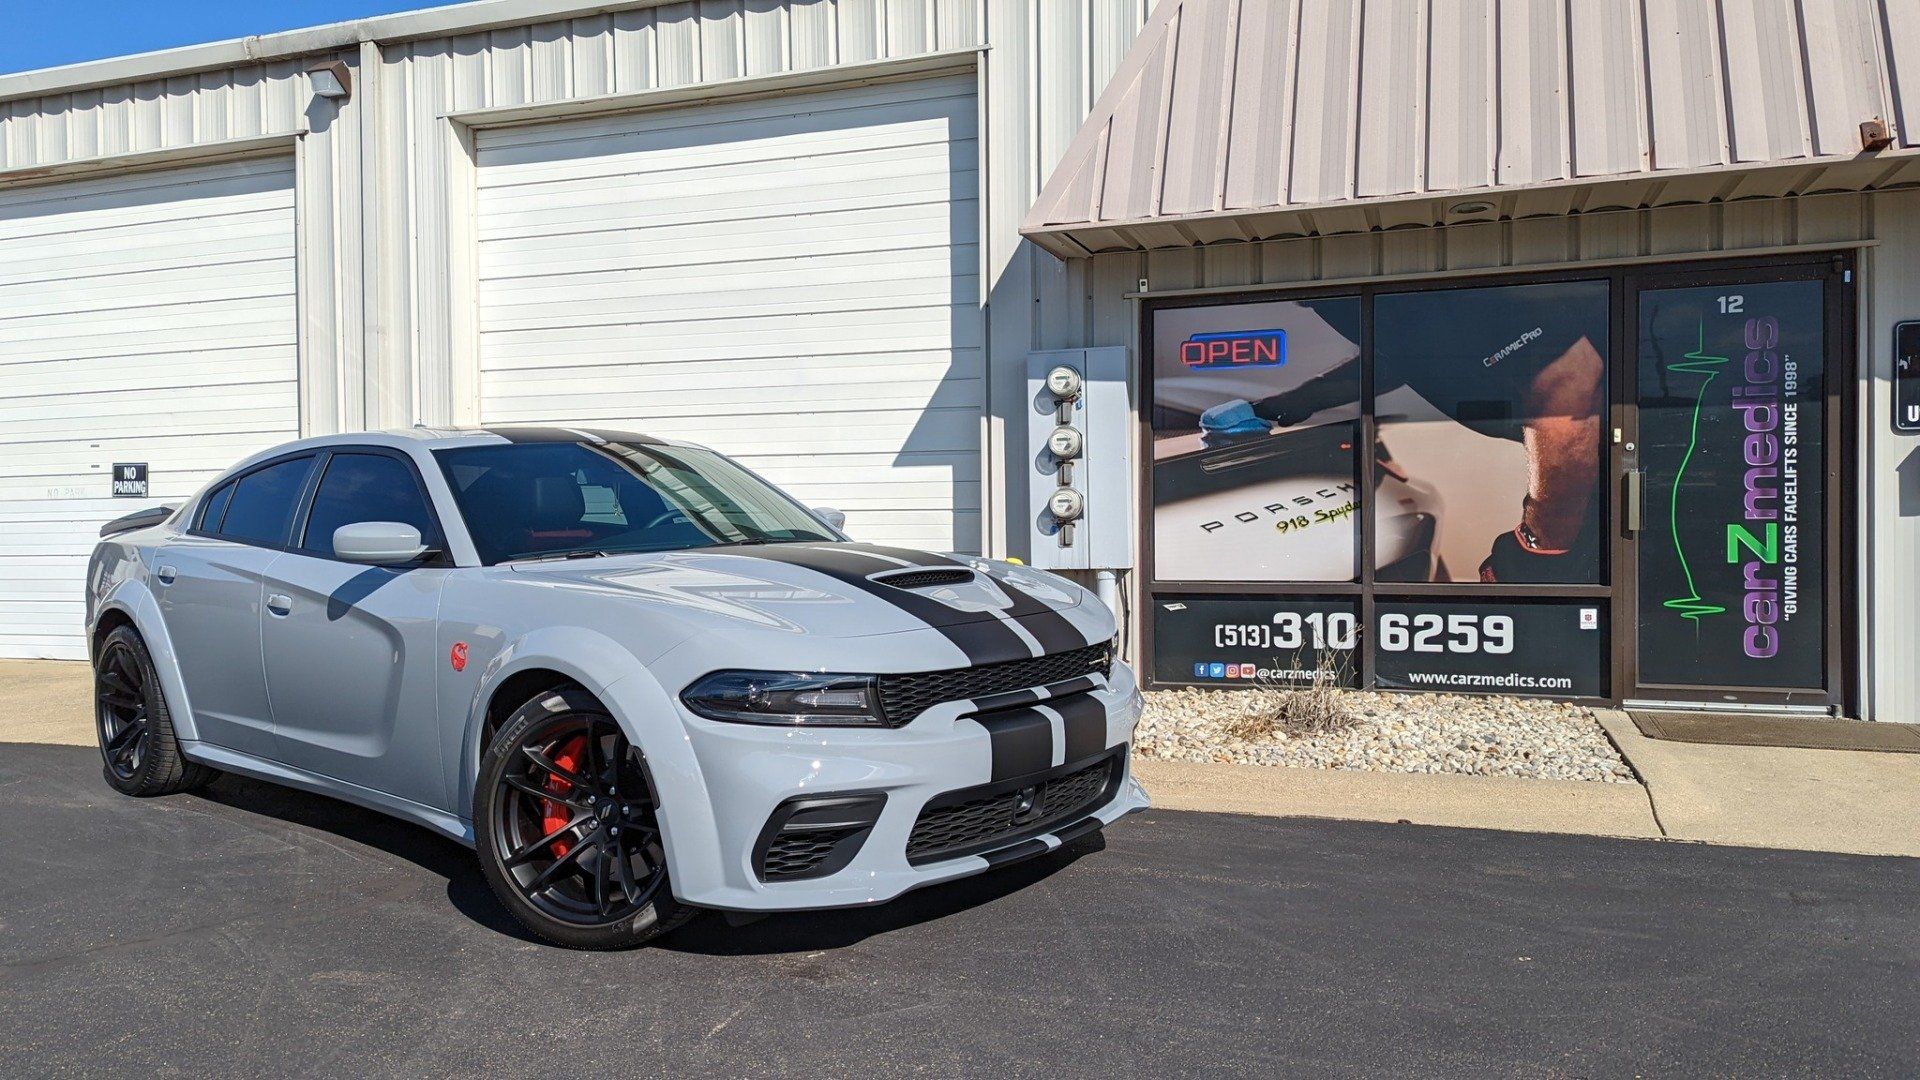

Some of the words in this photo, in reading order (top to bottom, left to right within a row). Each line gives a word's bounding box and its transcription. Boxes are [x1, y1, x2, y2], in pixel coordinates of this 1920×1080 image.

[1717, 295, 1744, 314] 12
[1181, 338, 1277, 365] OPEN
[1784, 403, 1798, 444] SINCE
[123, 467, 137, 480] NO
[1784, 446, 1798, 522] FACELIFTS
[114, 480, 147, 494] PARKING
[1276, 515, 1310, 534] 918
[1784, 525, 1798, 563] CARS
[1273, 612, 1357, 650] 310
[1380, 613, 1514, 654] 6259
[1408, 671, 1572, 689] www.carzmedics.com
